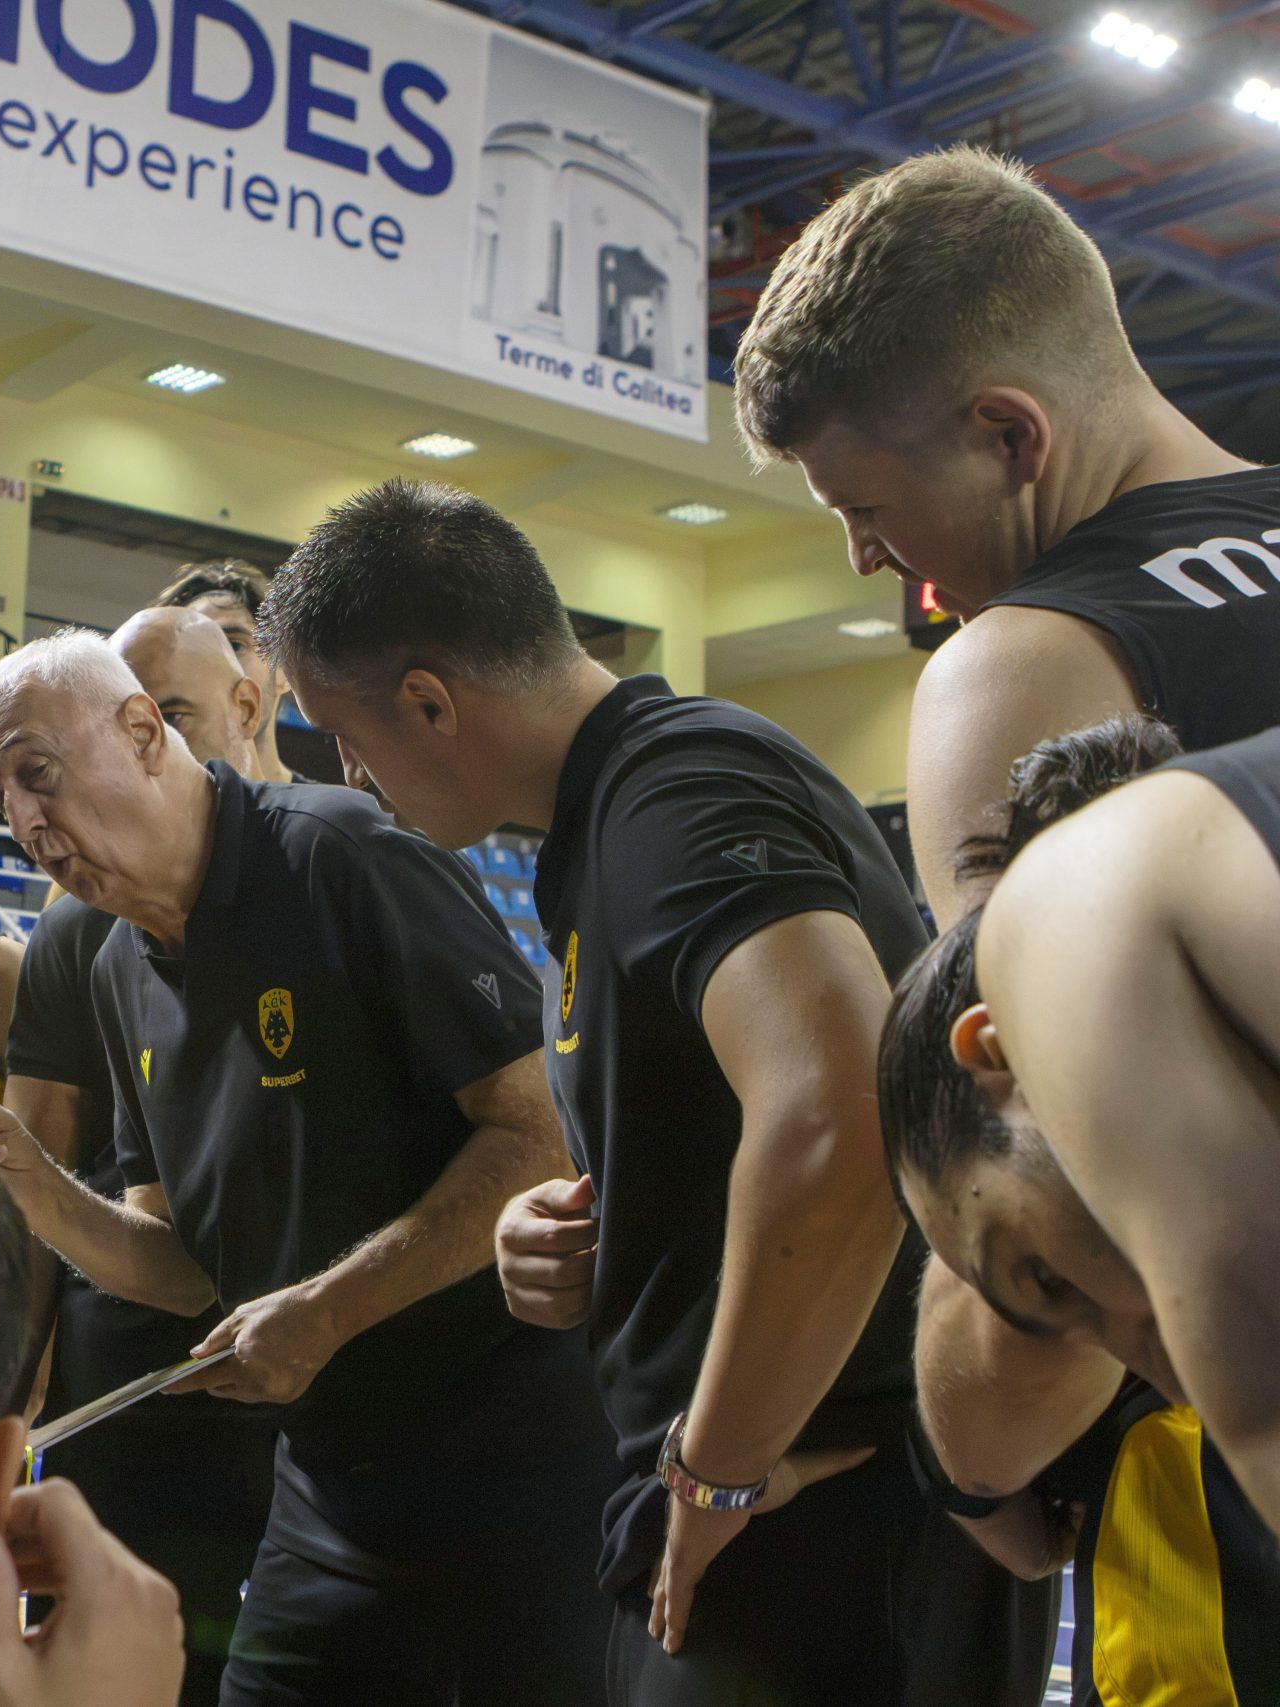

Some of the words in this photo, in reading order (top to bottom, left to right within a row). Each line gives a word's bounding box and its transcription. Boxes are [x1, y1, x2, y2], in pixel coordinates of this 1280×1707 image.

[495, 333, 574, 380] Terme
[582, 361, 605, 389] di
[613, 370, 692, 415] Calitea
[1139, 529, 1280, 609] m
[261, 1068, 307, 1087] SUPERBET
